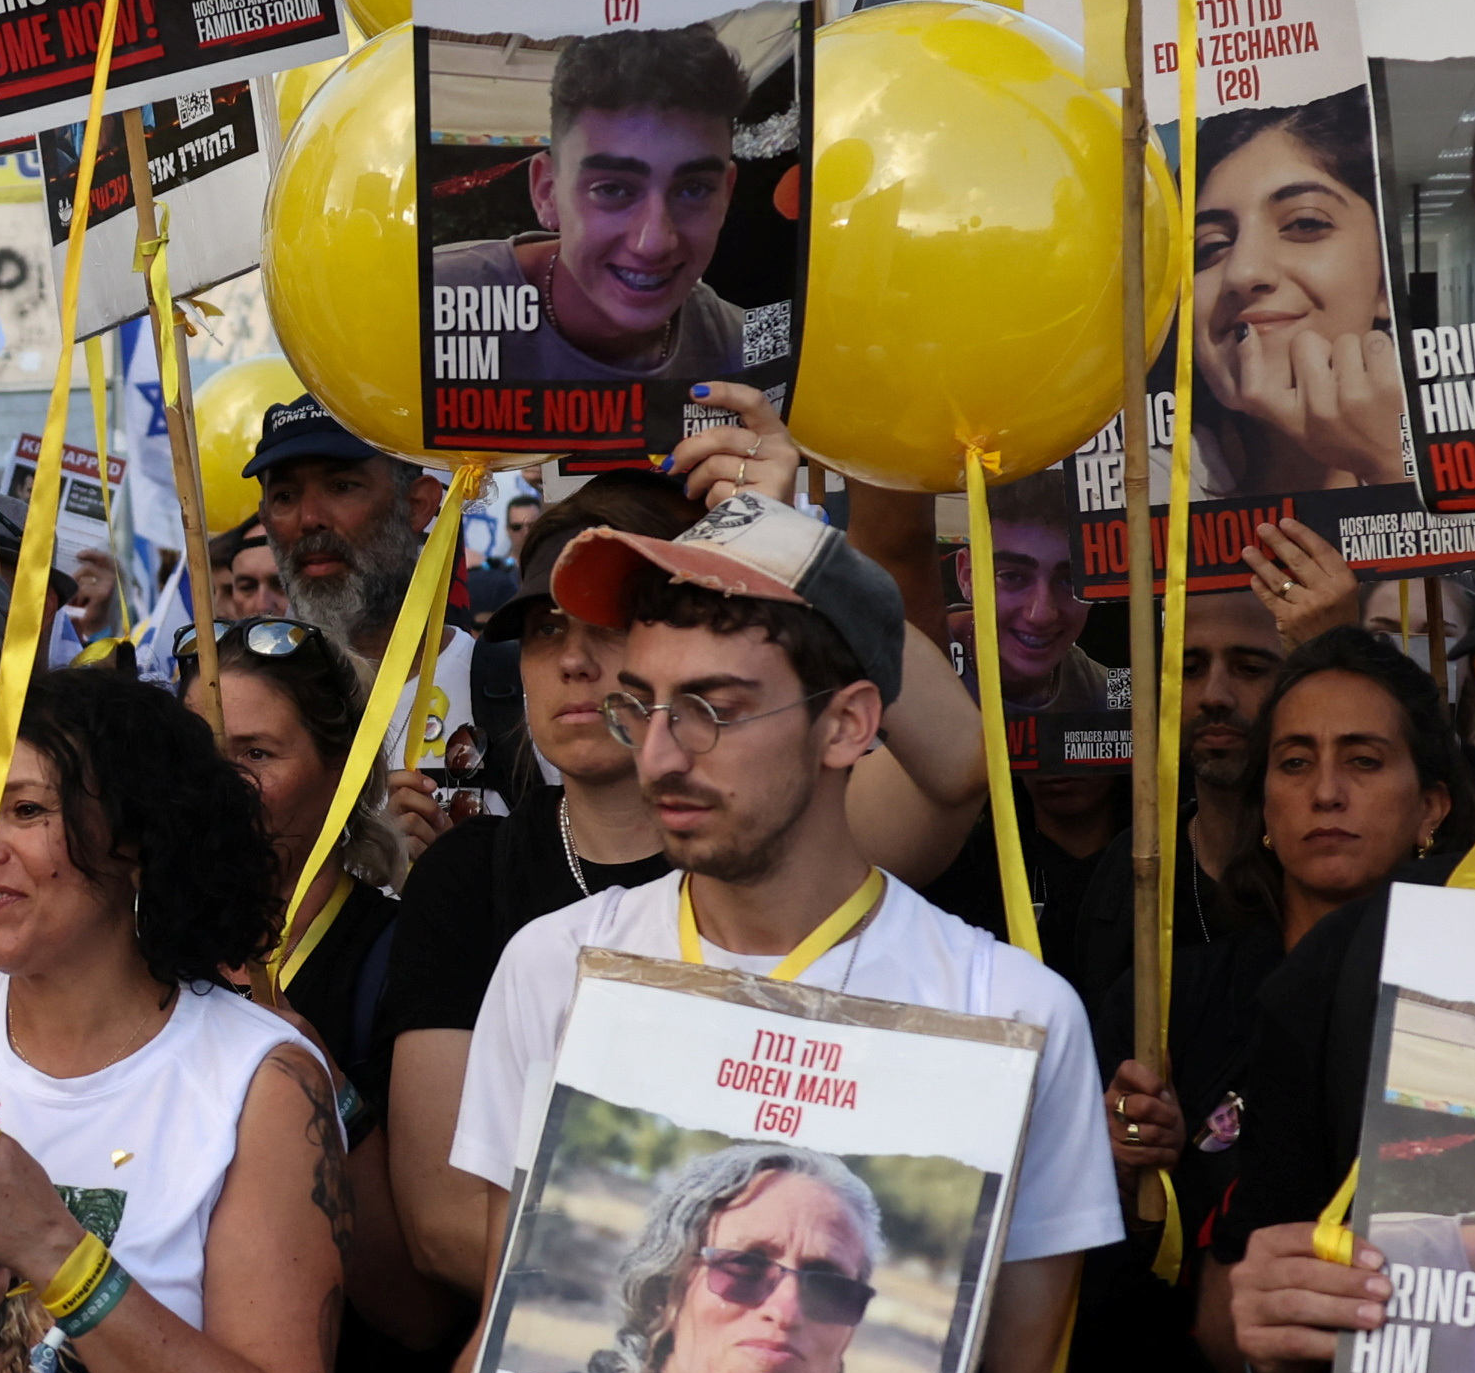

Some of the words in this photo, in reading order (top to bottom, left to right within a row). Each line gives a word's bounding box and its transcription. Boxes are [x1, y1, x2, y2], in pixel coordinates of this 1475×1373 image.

[195, 6, 262, 45] FAMILIES
[1210, 21, 1320, 63] ZECHARYA
[1216, 65, 1261, 106] (28)
[751, 1030, 793, 1065] גורן
[798, 1037, 843, 1073] מיה
[717, 1057, 788, 1097] GOREN
[794, 1074, 857, 1110] MAYA
[755, 1101, 803, 1137] (56)
